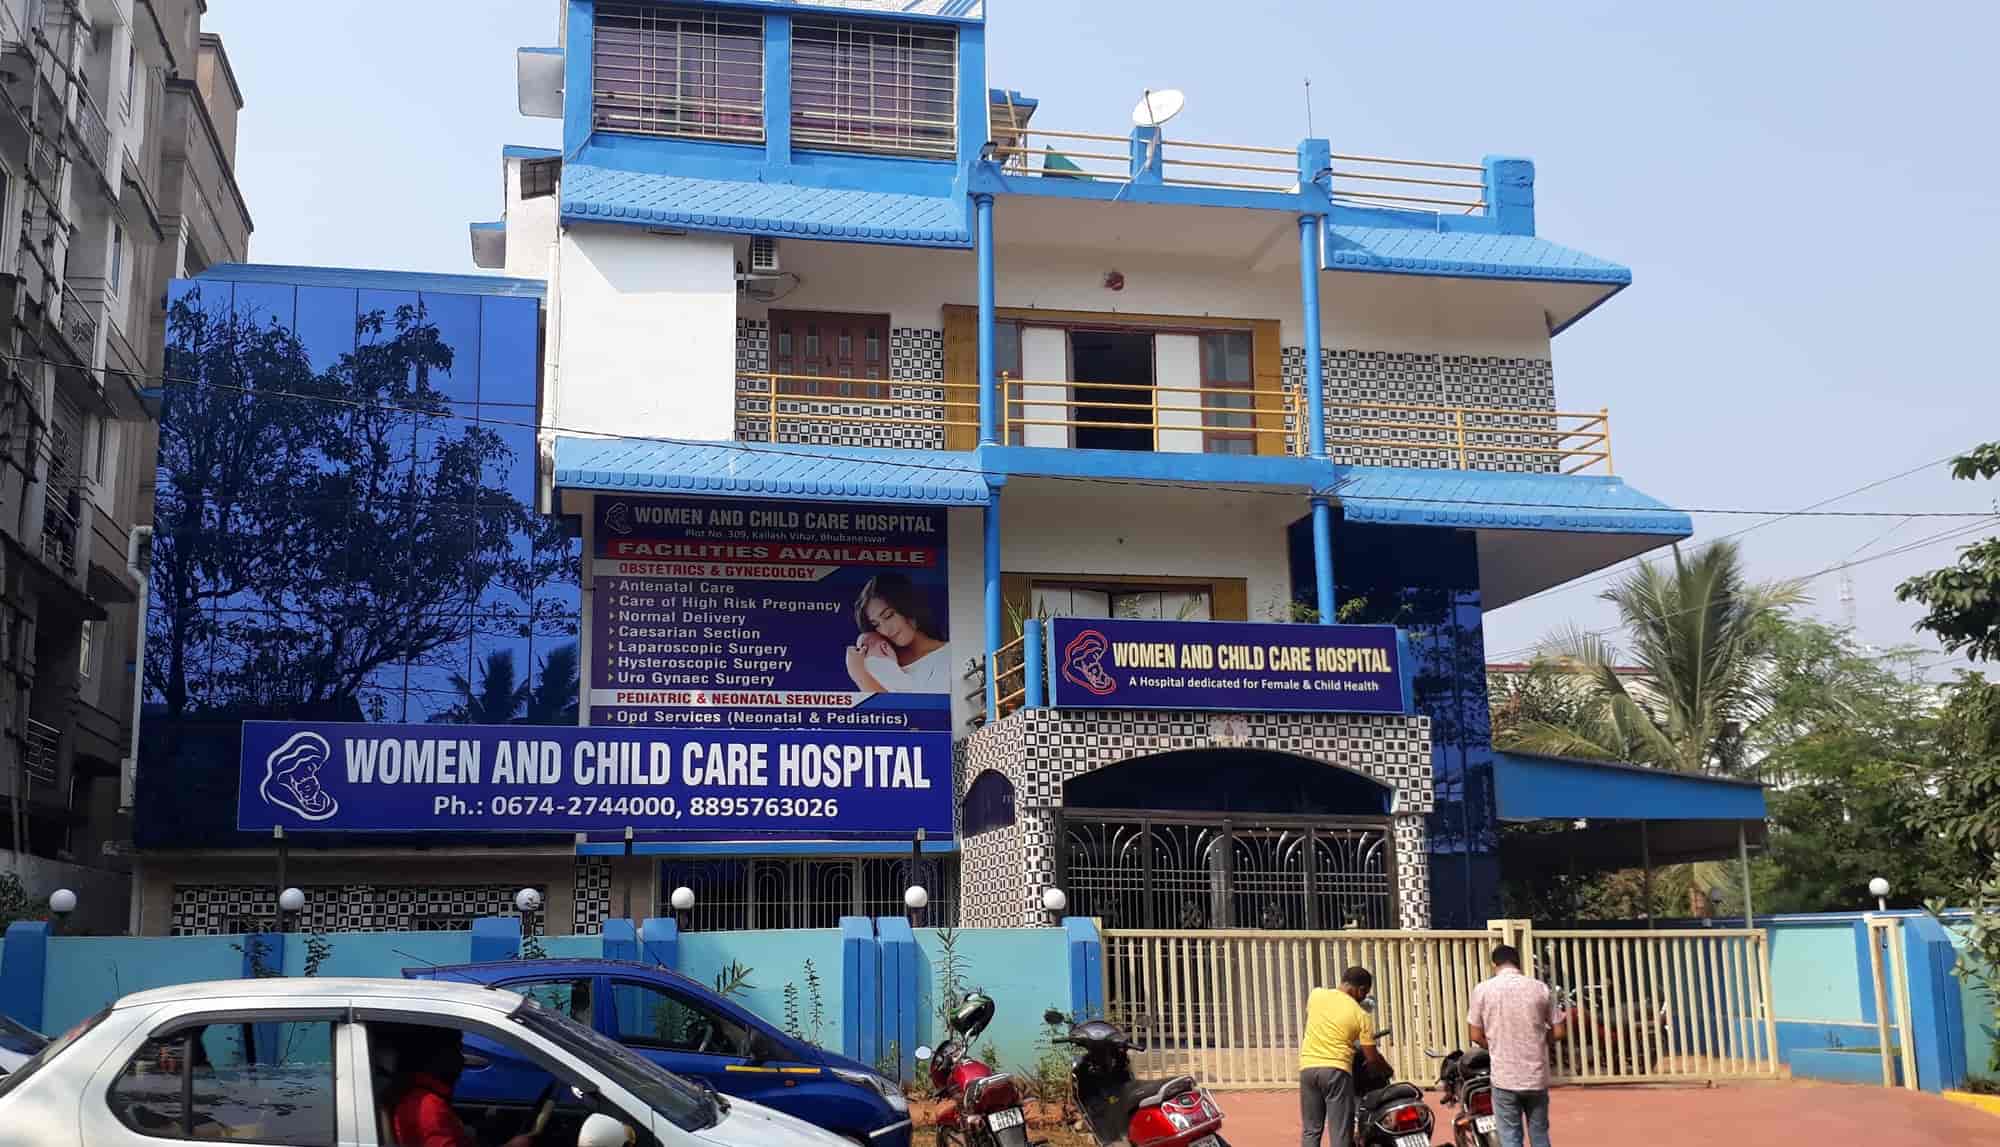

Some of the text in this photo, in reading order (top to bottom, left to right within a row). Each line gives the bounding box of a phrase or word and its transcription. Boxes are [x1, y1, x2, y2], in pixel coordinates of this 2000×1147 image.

[634, 507, 935, 532] WOMEN AND CHILD CARE HOSPITAL
[618, 542, 926, 563] FACILITIES AVAILABLE
[619, 562, 817, 580] OBSTETRICS & GYNECOLOGY
[619, 580, 735, 594] Antenatal Care
[618, 595, 841, 612] Care of High Risk Pregnancy
[618, 611, 746, 626] Normal Delivery
[618, 626, 760, 639] Caesarian Section
[618, 641, 787, 657] Laparoscopic Surgery
[618, 657, 792, 672] Hysteroscopic Surgery
[1112, 642, 1392, 673] WOMEN AND CHILD CARE HOSPITAL
[618, 672, 775, 687] Uro Gynaec Surgery
[1129, 676, 1379, 691] A Hospital dedicated for Female & Child Health
[616, 692, 852, 706] PEDIATRIC & NEONATAL SERVICES
[617, 711, 908, 726] Opd Services (Neonatal & Pediatrics)
[345, 738, 931, 789] WOMEN AND CHILD CARE HOSPITAL
[434, 796, 838, 820] Ph.: 0674-2744000, 8895763026
